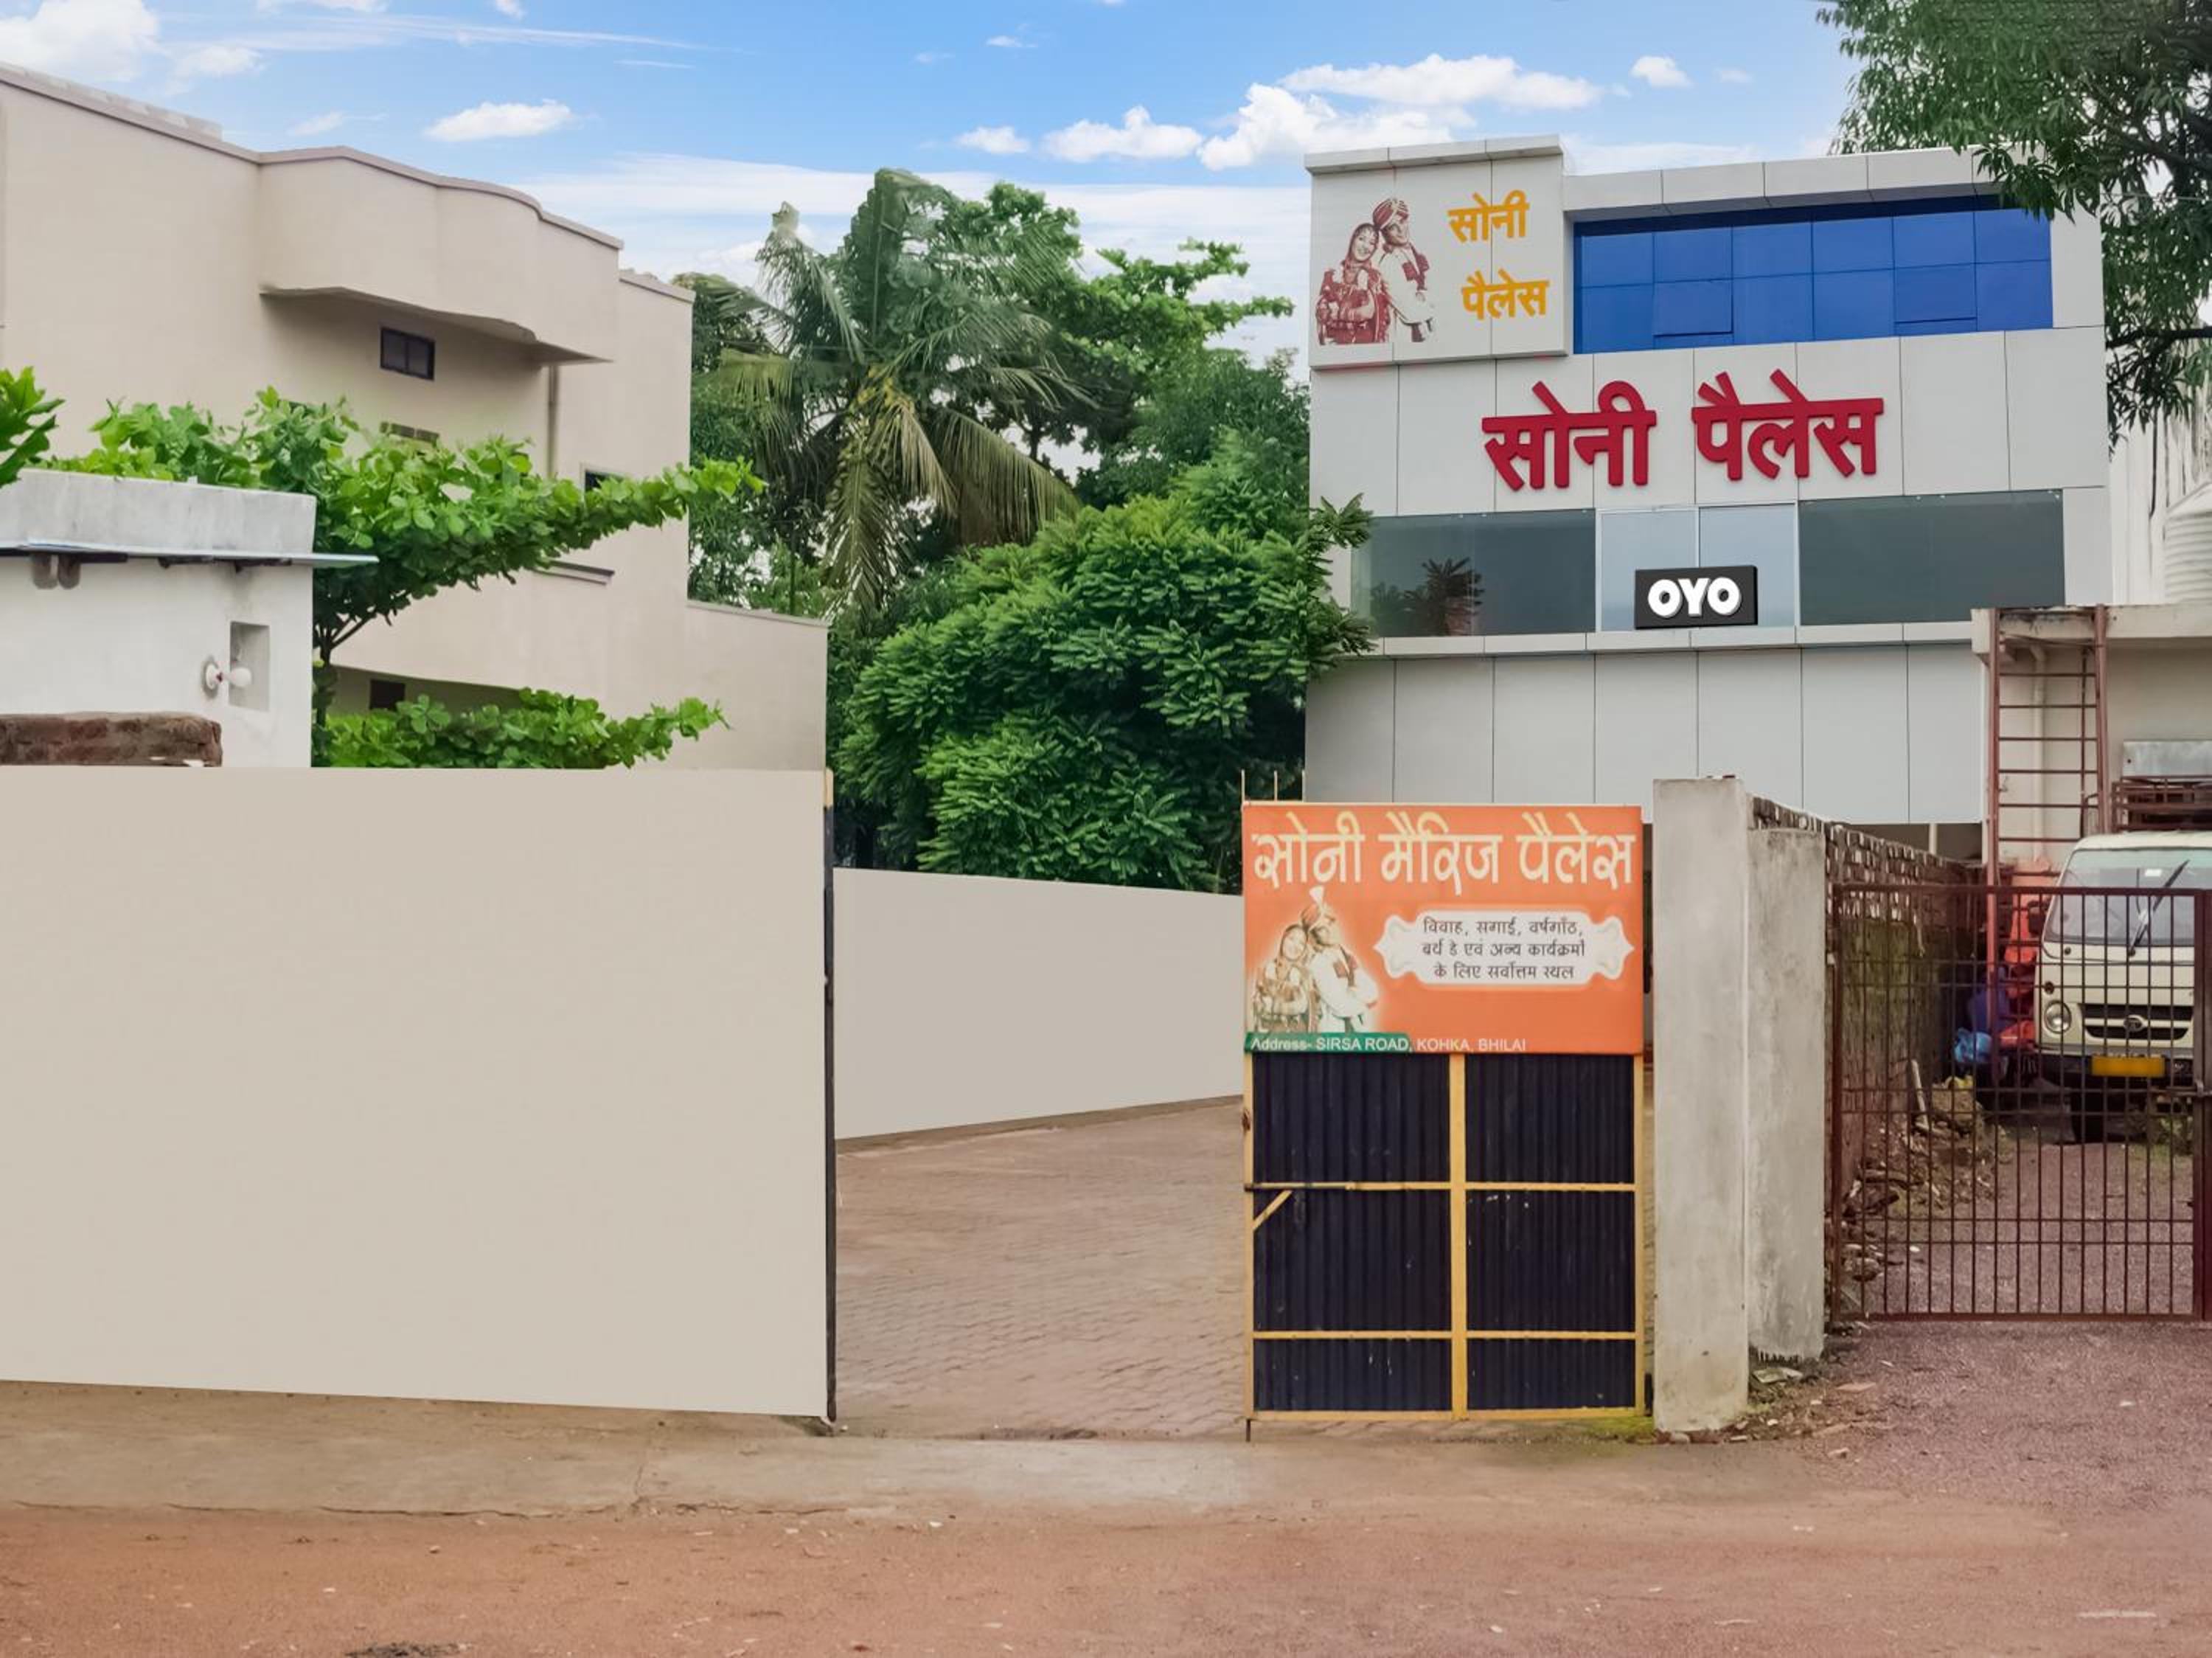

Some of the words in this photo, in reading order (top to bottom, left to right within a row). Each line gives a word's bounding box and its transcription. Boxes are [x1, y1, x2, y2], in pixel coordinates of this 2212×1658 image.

[1447, 190, 1530, 243] सोनी
[1461, 268, 1550, 320] पैलेस
[1482, 381, 1657, 491] सोनी
[1691, 369, 1884, 481] पैलेस
[1647, 577, 1742, 618] OYO
[1251, 811, 1365, 889] सोनी
[1378, 811, 1503, 895] मैरिज
[1516, 812, 1635, 889] पैलेस
[1453, 960, 1481, 979] लिए
[1316, 1037, 1361, 1051] SIRSA
[1478, 1038, 1526, 1052] BHILAI
